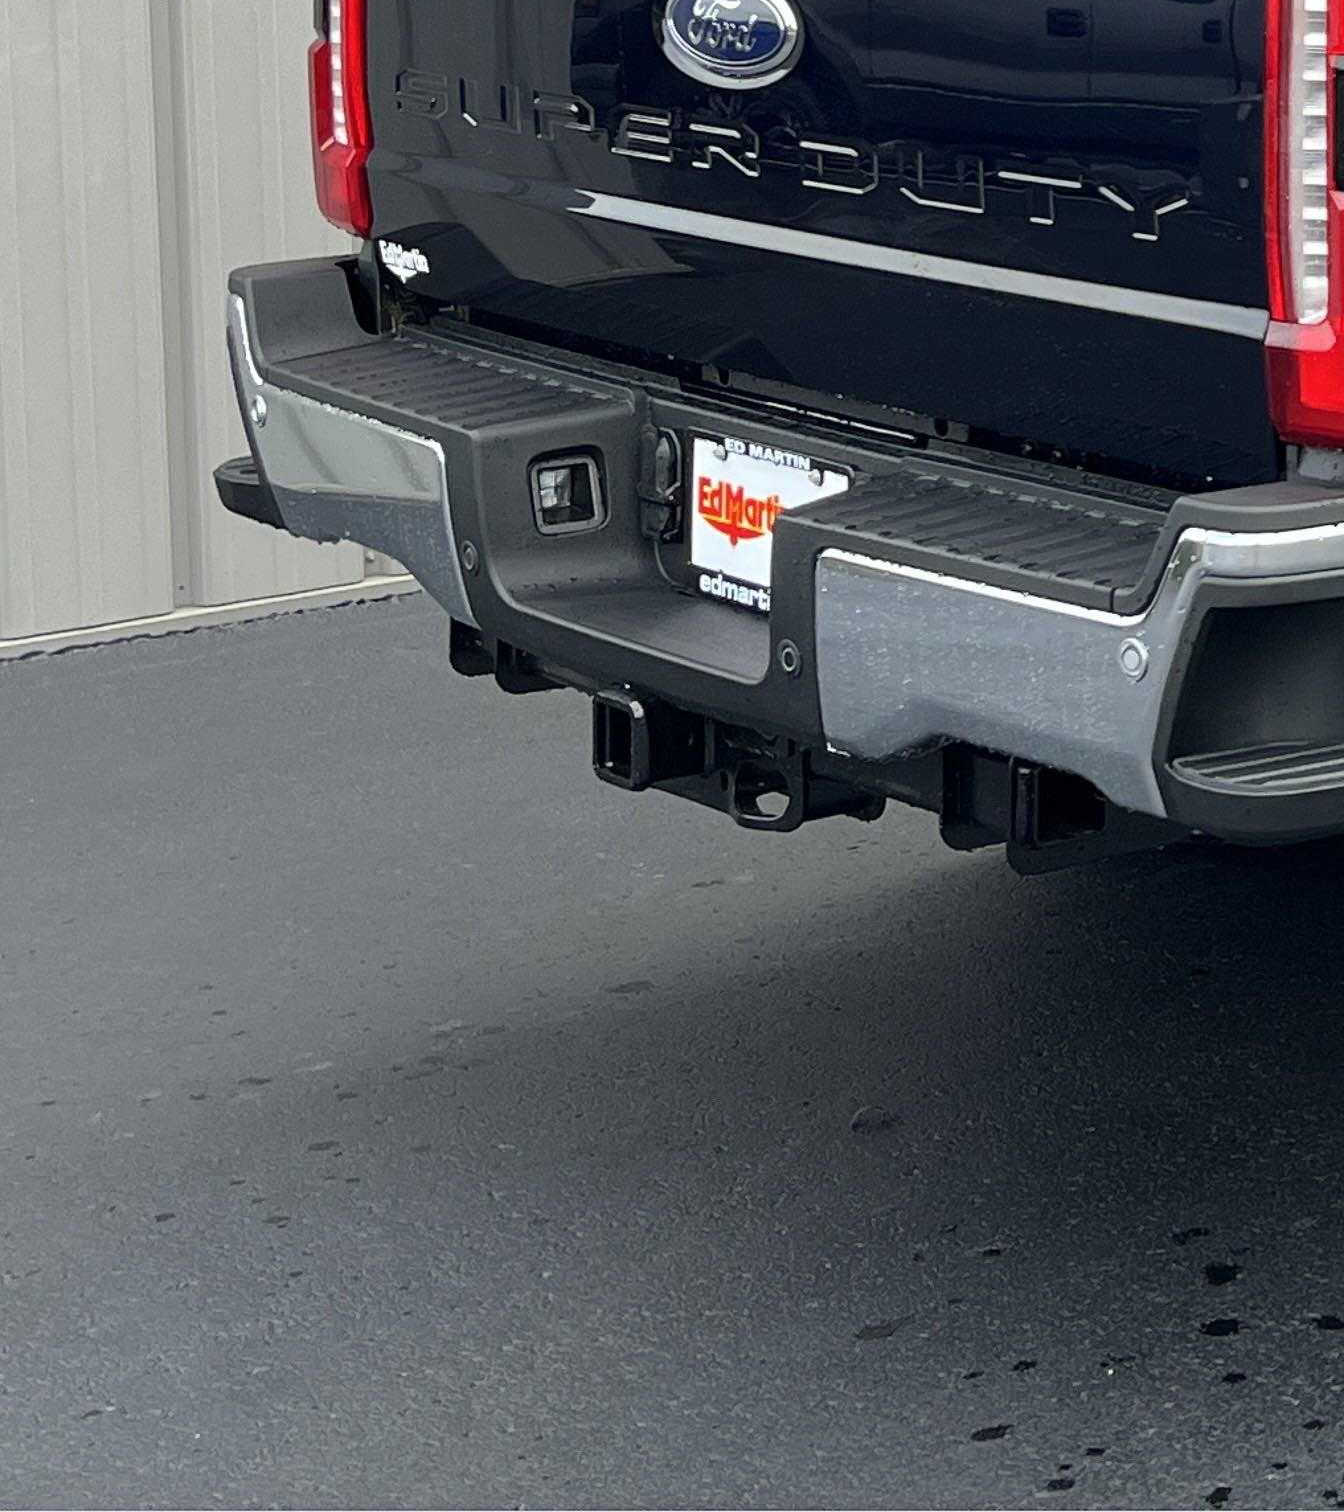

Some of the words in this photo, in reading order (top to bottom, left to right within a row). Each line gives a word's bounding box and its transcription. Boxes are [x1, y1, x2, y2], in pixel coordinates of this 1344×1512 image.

[395, 66, 760, 177] SUPER
[799, 138, 1192, 242] DUTY
[724, 437, 746, 454] ED
[748, 443, 811, 471] MARTIN
[698, 476, 784, 533] EdMarti
